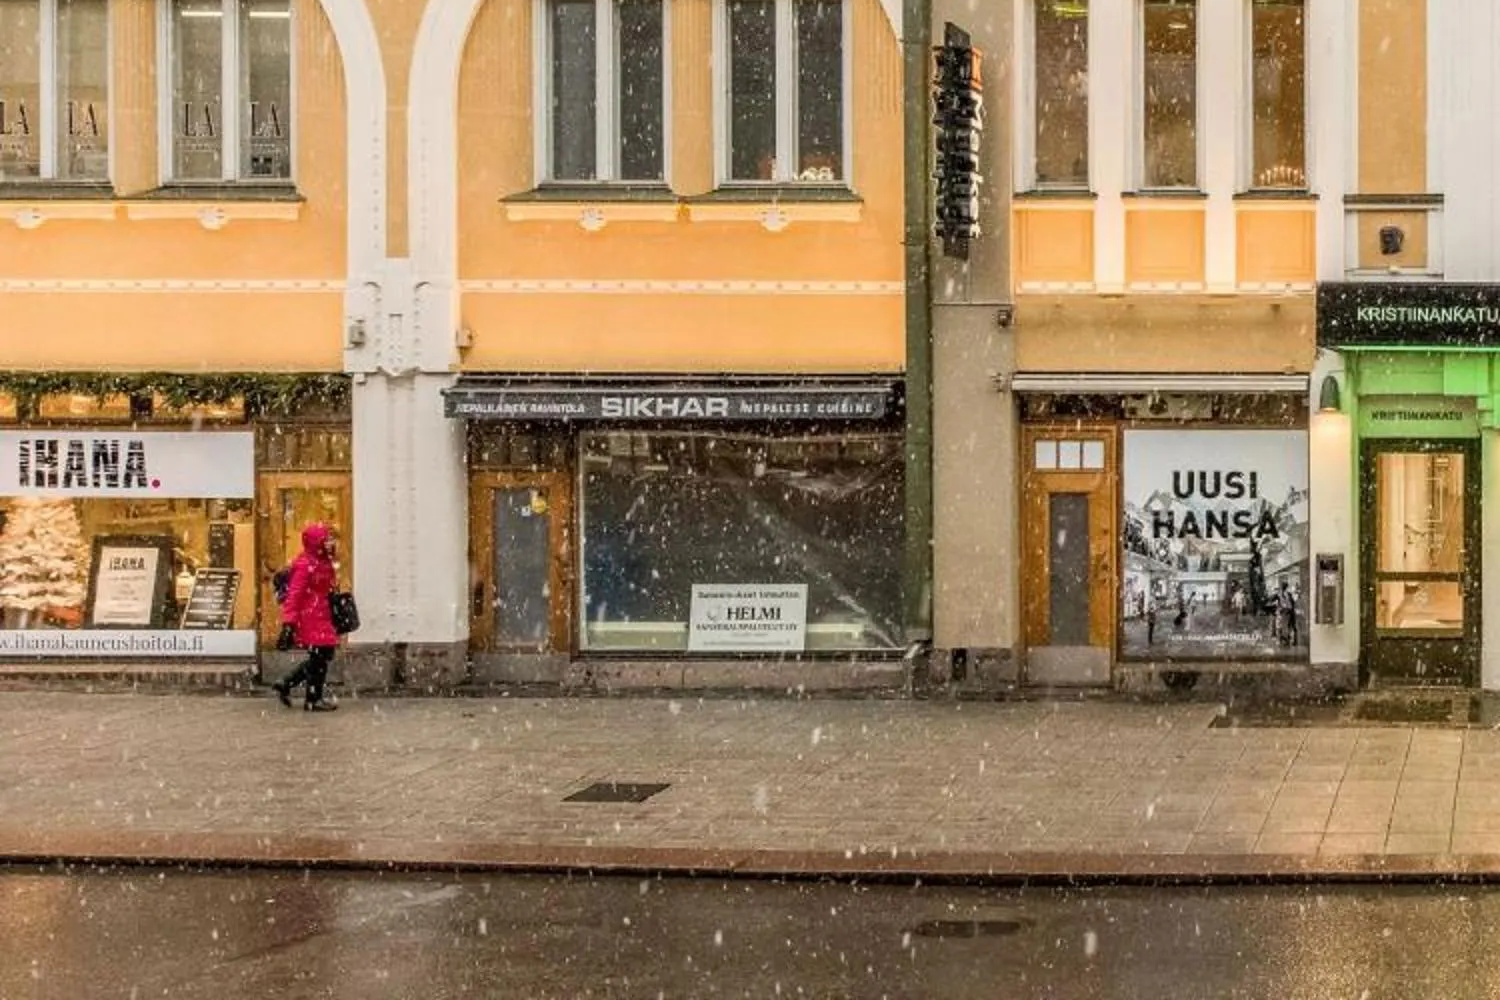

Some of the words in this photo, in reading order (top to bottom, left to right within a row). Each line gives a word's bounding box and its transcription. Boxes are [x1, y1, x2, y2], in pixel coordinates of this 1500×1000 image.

[1357, 307, 1498, 323] KRISTIINANKATU
[602, 397, 728, 417] SIKHAR
[740, 402, 809, 413] NEPALESE
[1172, 471, 1258, 499] UUSI
[1152, 511, 1280, 539] HANSA
[727, 607, 782, 620] HELMI
